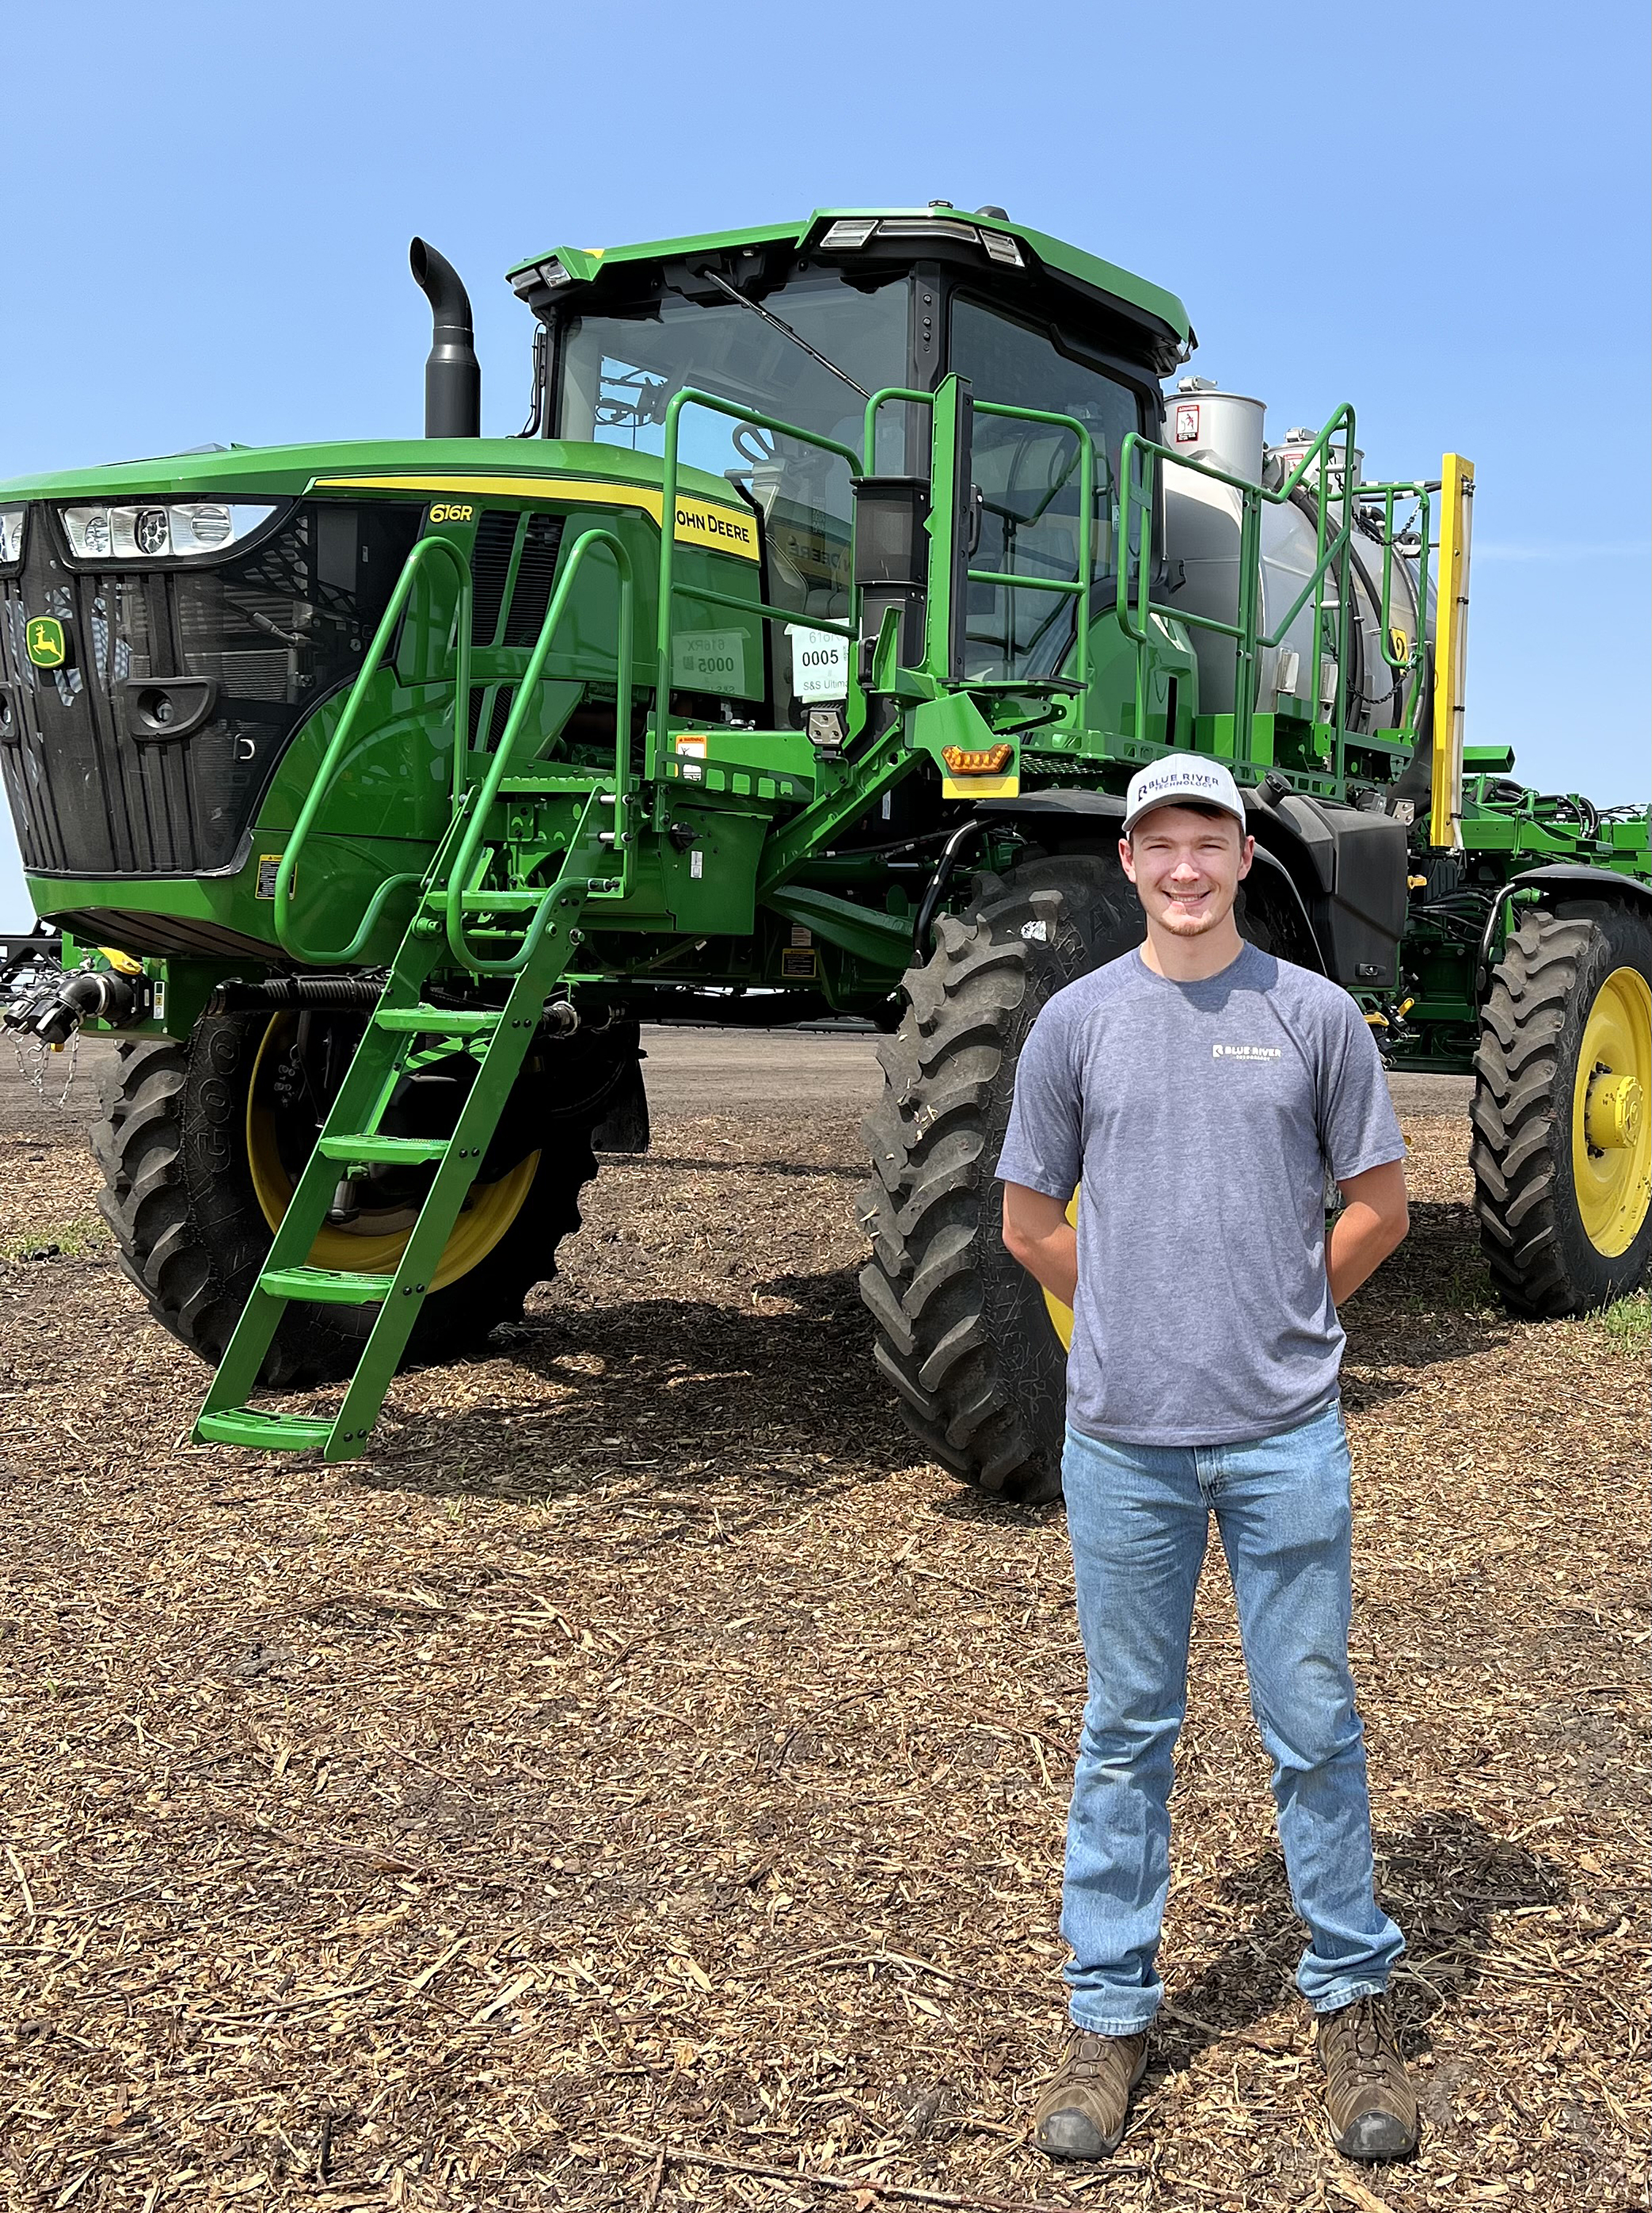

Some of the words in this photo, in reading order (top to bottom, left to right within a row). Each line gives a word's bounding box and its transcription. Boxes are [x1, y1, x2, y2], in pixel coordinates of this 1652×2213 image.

[430, 503, 473, 523] 616R
[676, 510, 706, 531] OHN
[707, 513, 750, 544] DEERE
[802, 649, 839, 666] 0005
[803, 680, 821, 690] S&S
[1149, 774, 1178, 789] BLUE
[1182, 773, 1219, 786] RIVER
[1155, 780, 1212, 791] TECHNOLOGY
[1225, 1046, 1250, 1055] BLUE
[1253, 1047, 1281, 1057] RIVER
